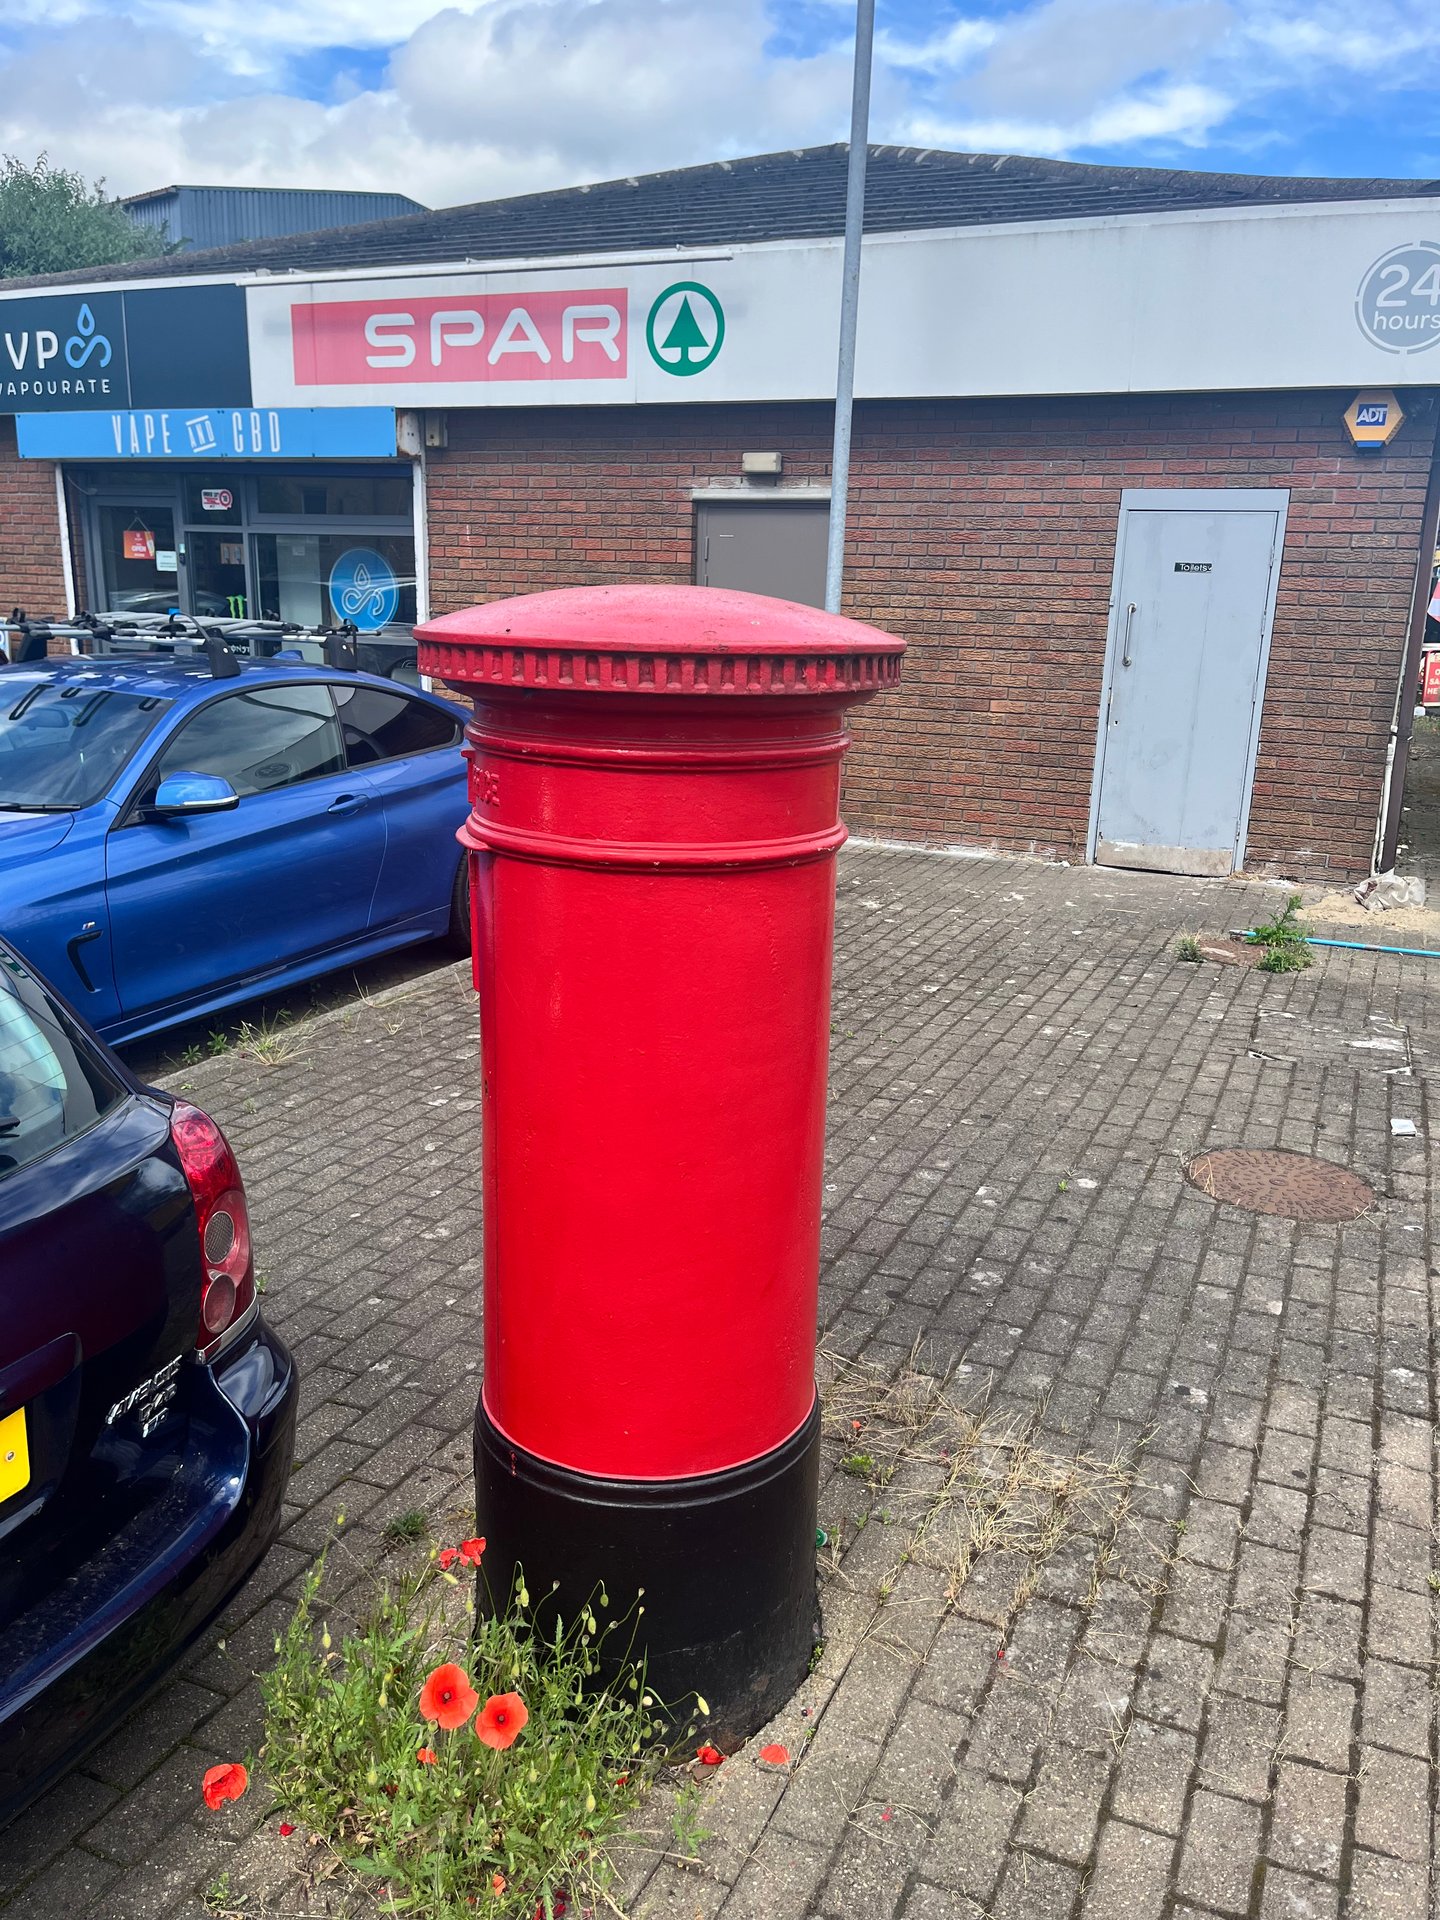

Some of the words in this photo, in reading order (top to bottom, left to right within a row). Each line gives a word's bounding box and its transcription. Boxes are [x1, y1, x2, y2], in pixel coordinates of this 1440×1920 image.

[1376, 263, 1440, 307] 24
[364, 304, 621, 369] SPAR
[1373, 311, 1440, 330] hours
[5, 330, 58, 370] VP
[112, 413, 172, 454] VAPE
[186, 418, 216, 450] AND
[232, 411, 281, 453] CBD
[1356, 407, 1388, 423] ADT
